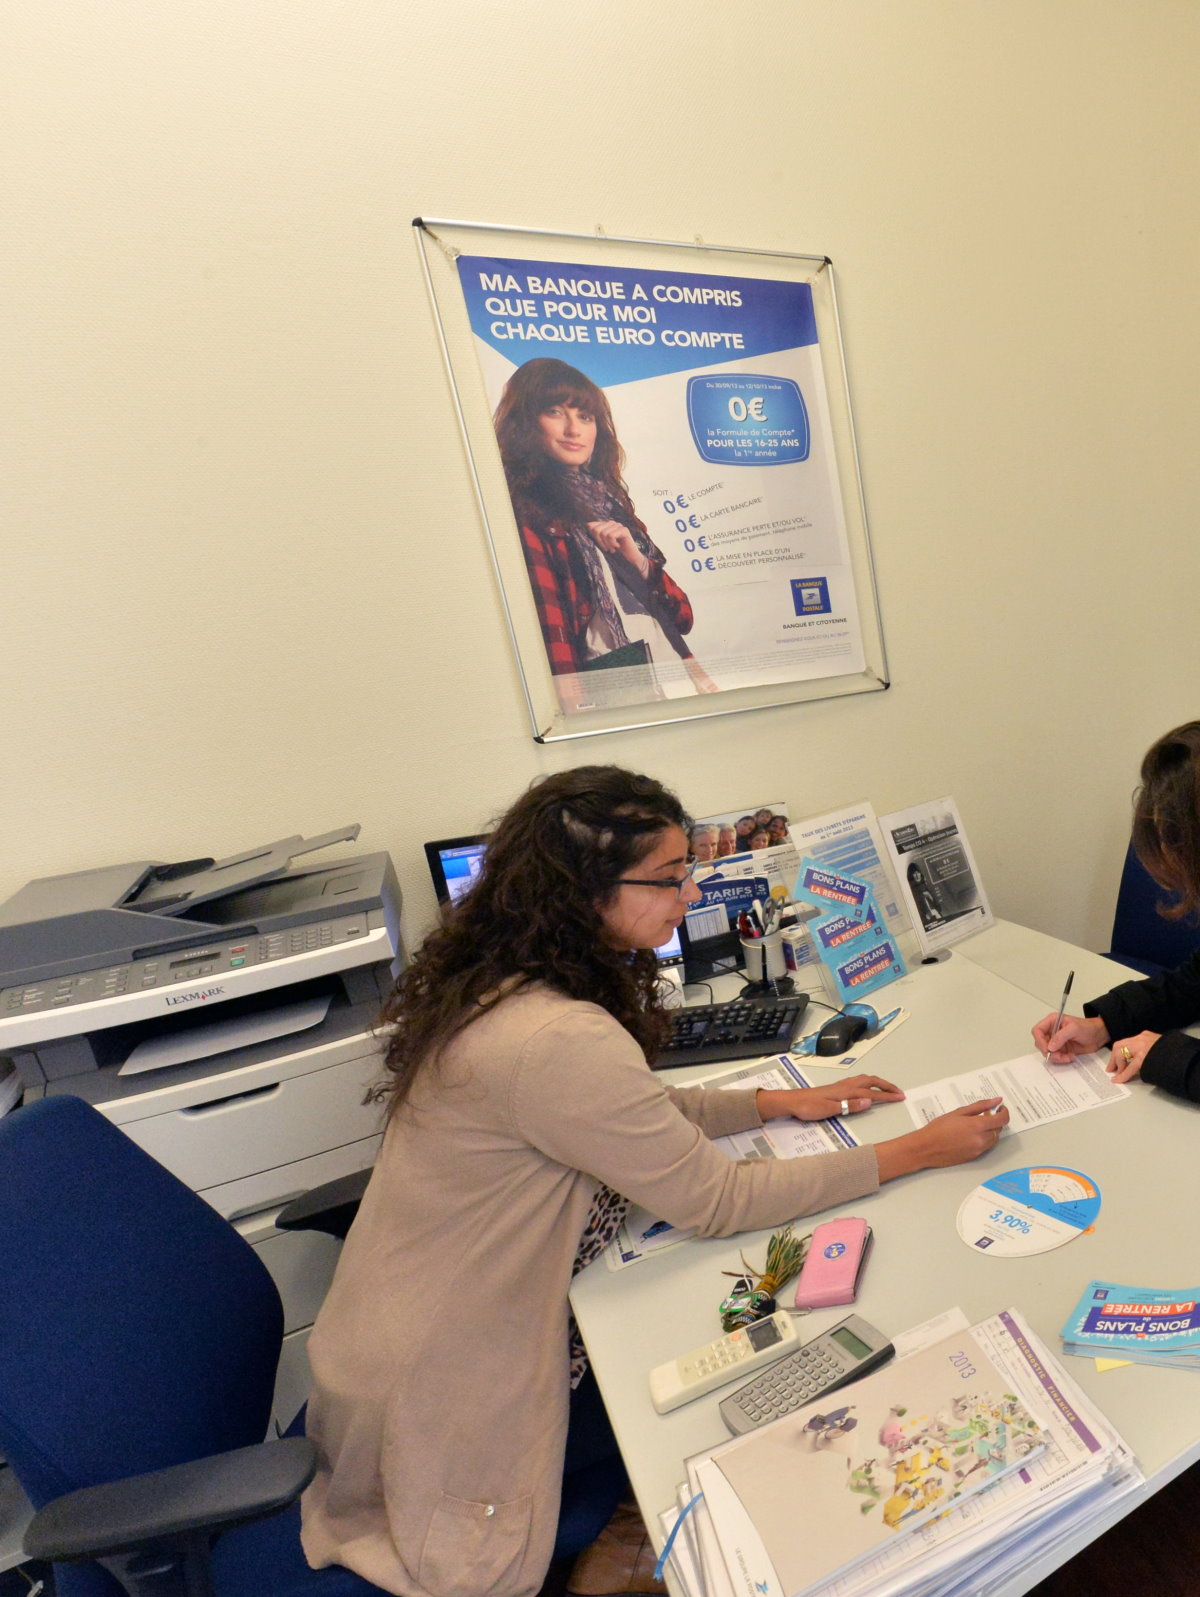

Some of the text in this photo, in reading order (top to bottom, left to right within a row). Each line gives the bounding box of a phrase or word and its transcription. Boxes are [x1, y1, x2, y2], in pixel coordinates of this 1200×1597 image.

[479, 272, 743, 307] MA BANQUE A COMPRIS
[485, 297, 657, 324] QUE POUR MOI
[490, 321, 745, 349] CHAQUE EURO COMPTE
[728, 396, 768, 422] 0€
[716, 428, 749, 437] Formule
[750, 428, 760, 437] de
[707, 438, 800, 448] POUR LES 16-25 ANS
[709, 507, 731, 519] CARTE
[726, 552, 741, 560] MISE
[753, 549, 773, 557] PLACE
[812, 872, 860, 894] BONS PLANS
[704, 886, 753, 901] TARIFS
[810, 885, 856, 905] LA RENTRÉE
[825, 919, 845, 935] BONS
[830, 937, 841, 947] LA
[844, 946, 886, 975] BONS PLANS
[850, 977, 860, 986] LA
[165, 986, 225, 1006] LEXMARK
[989, 1209, 1033, 1234] 3,90%
[1104, 1301, 1193, 1315] LA RENTRÉE
[1095, 1318, 1191, 1333] BONS PLANS
[948, 1350, 977, 1379] 2013
[1016, 1336, 1047, 1380] DIAGNOSTIC
